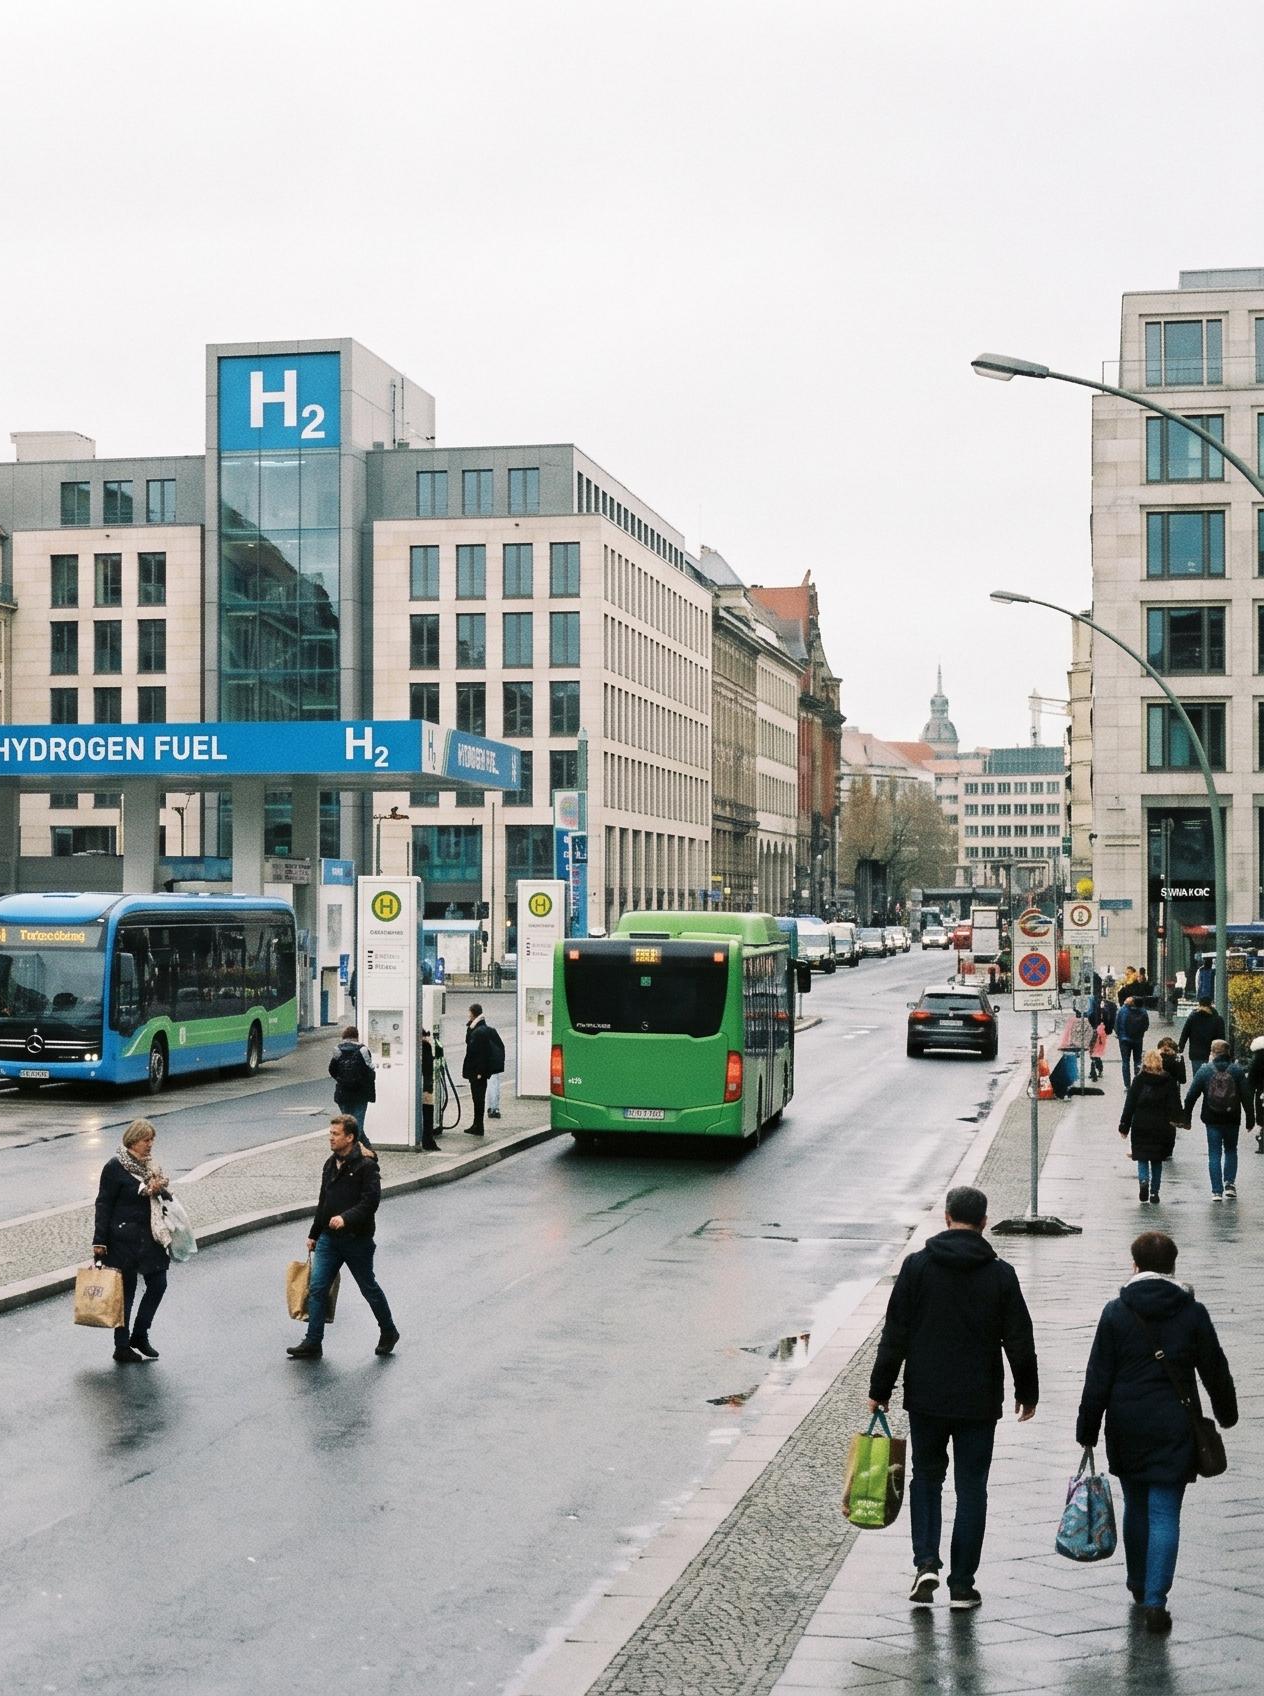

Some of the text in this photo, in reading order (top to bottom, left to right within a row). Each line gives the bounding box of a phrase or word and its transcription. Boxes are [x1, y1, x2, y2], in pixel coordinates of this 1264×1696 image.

[250, 369, 325, 439] H2
[155, 735, 228, 761] FUEL
[345, 726, 389, 767] H2
[379, 898, 394, 915] H
[535, 898, 546, 912] H
